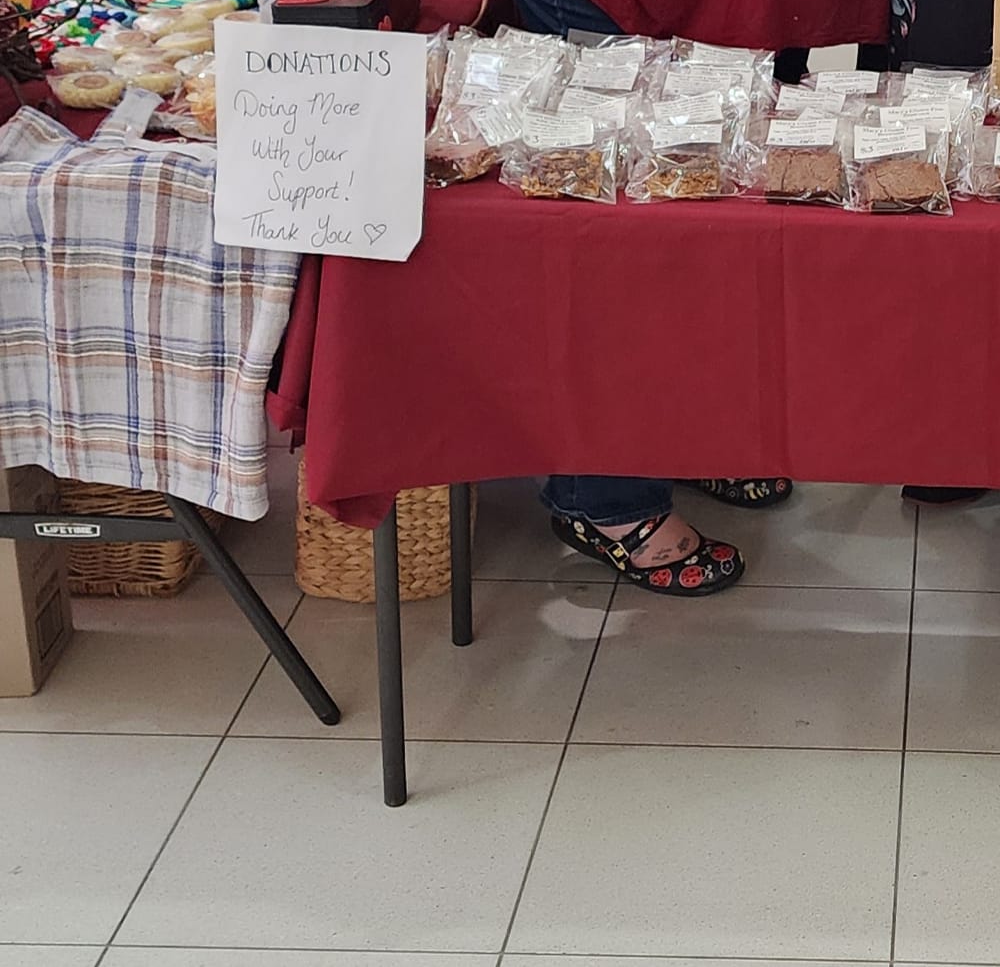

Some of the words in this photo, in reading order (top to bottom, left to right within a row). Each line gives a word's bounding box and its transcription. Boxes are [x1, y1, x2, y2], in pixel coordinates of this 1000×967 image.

[245, 50, 392, 76] DONATIONS
[234, 89, 298, 134] Doing
[308, 92, 361, 125] More
[252, 137, 290, 168] With
[298, 136, 348, 171] Your
[268, 170, 354, 210] Support!
[242, 209, 300, 239] Thank
[311, 214, 352, 248] You
